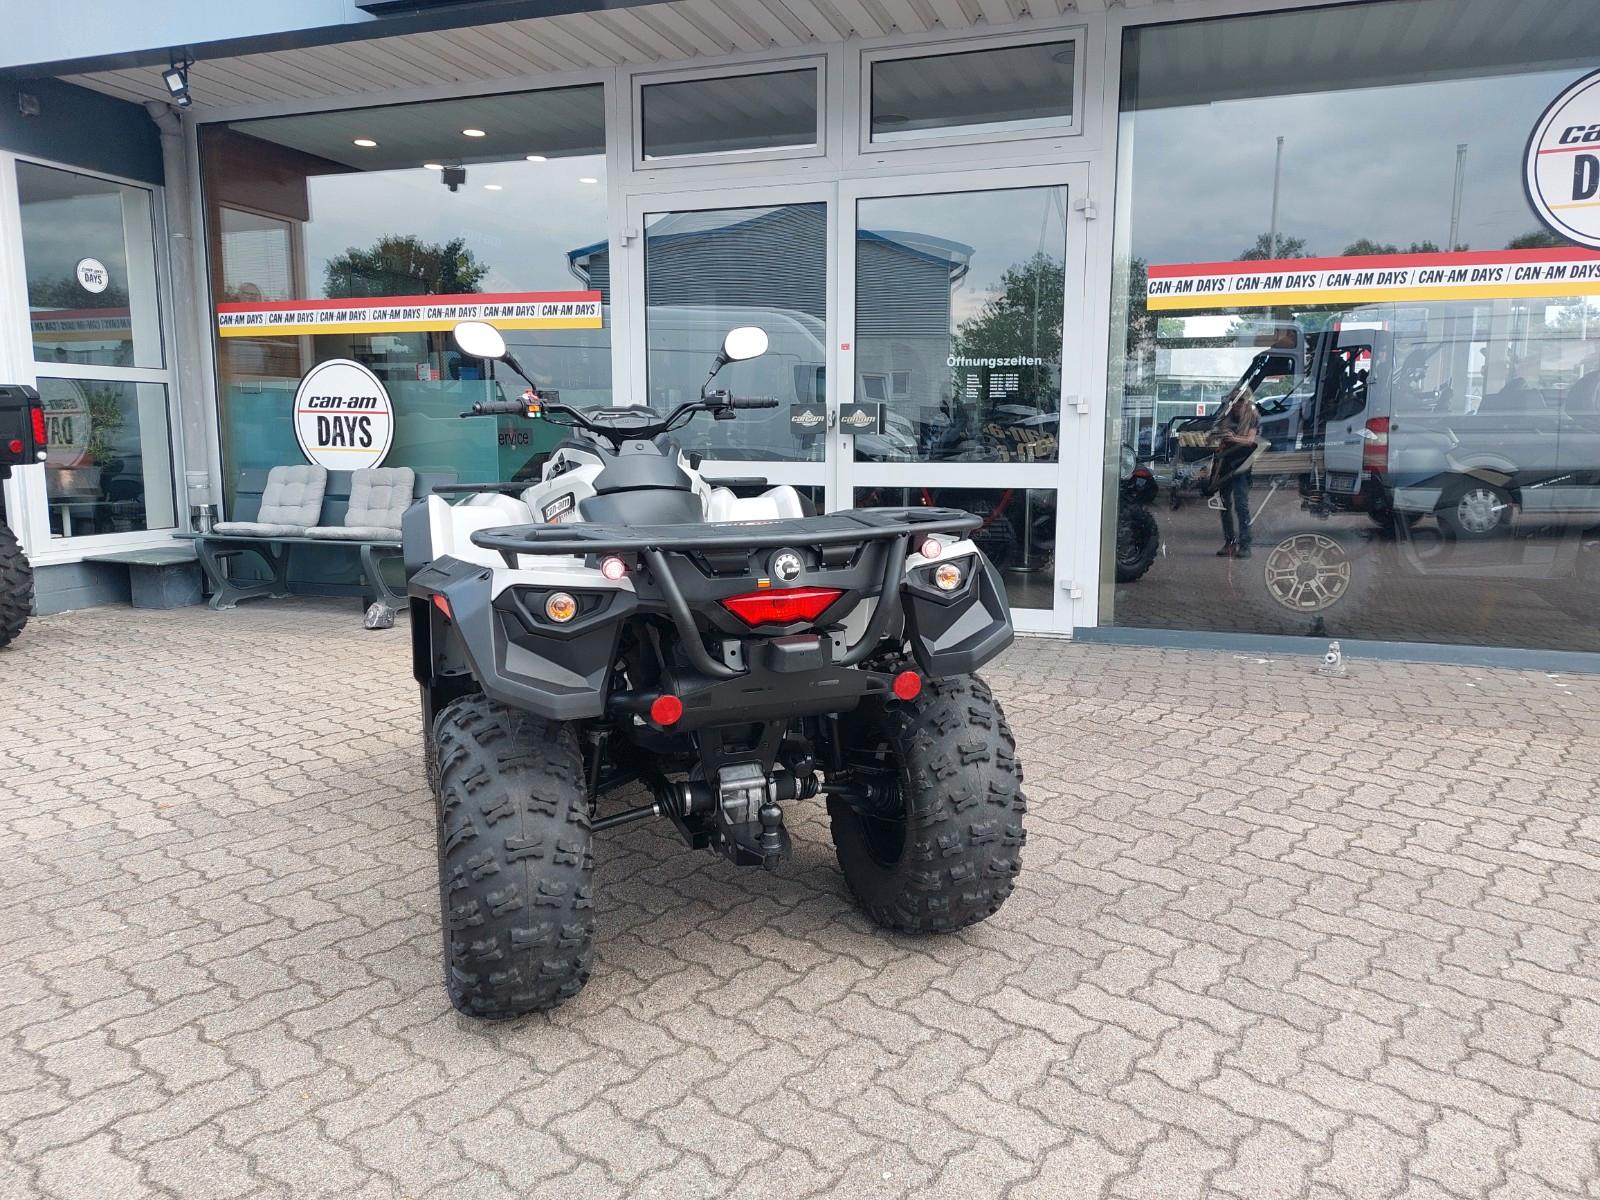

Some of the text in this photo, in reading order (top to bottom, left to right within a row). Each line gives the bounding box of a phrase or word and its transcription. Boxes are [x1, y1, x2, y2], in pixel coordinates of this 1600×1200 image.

[1572, 154, 1600, 201] D
[84, 272, 103, 286] DAYS
[1148, 264, 1600, 294] CAN-AM DAYS CAN-AM DAYS CAN-AM DAYS CAN-AM DAYS CAN-AM DAYS
[220, 304, 596, 325] CAN-AM DAYS CAN-AM DAYS CAN-AM DAYS CAN-AM DAYS CAN-AM DAYS CAN-AM DAYS CAN-AM DAYS
[946, 354, 1042, 369] Öffnungszeiten
[308, 396, 377, 409] can-am
[317, 415, 373, 448] DAYS
[498, 432, 529, 446] ervice
